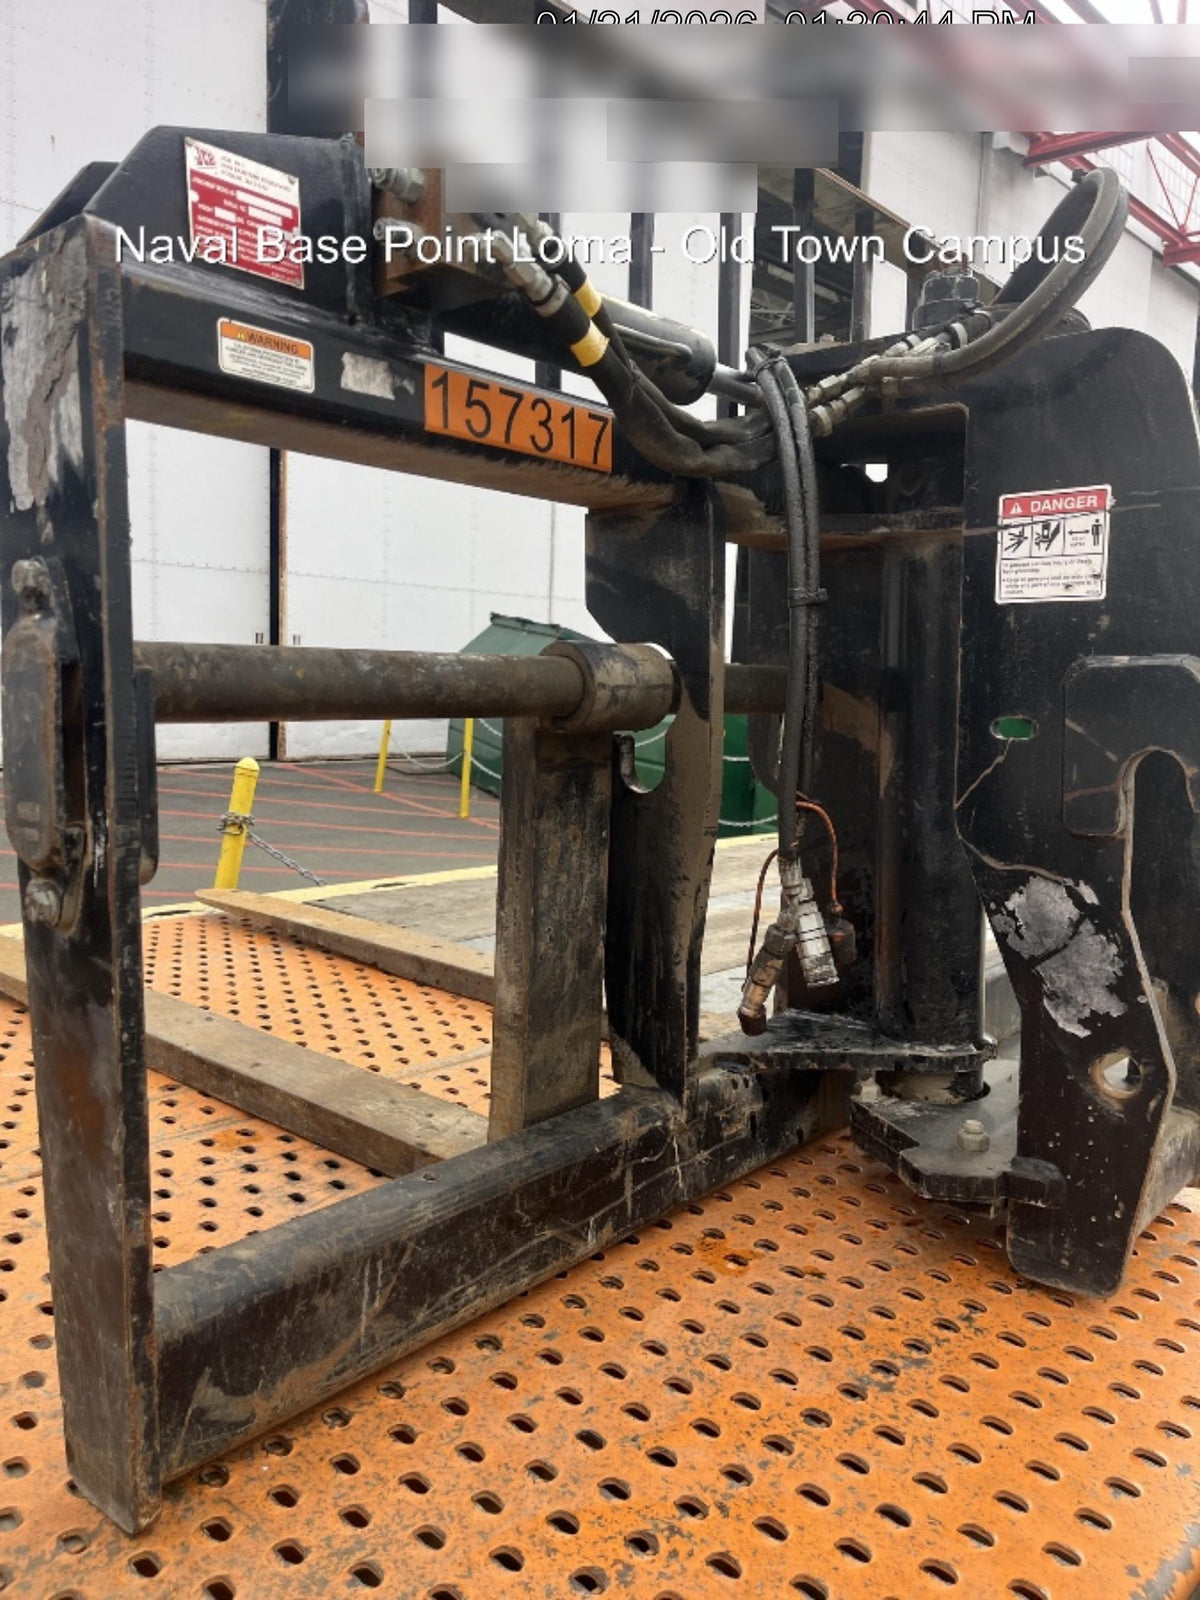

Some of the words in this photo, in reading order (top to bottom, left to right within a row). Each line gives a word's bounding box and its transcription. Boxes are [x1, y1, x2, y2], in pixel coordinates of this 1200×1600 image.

[246, 329, 298, 354] WARNING
[431, 370, 610, 465] 157317
[1030, 495, 1098, 513] DANGER
